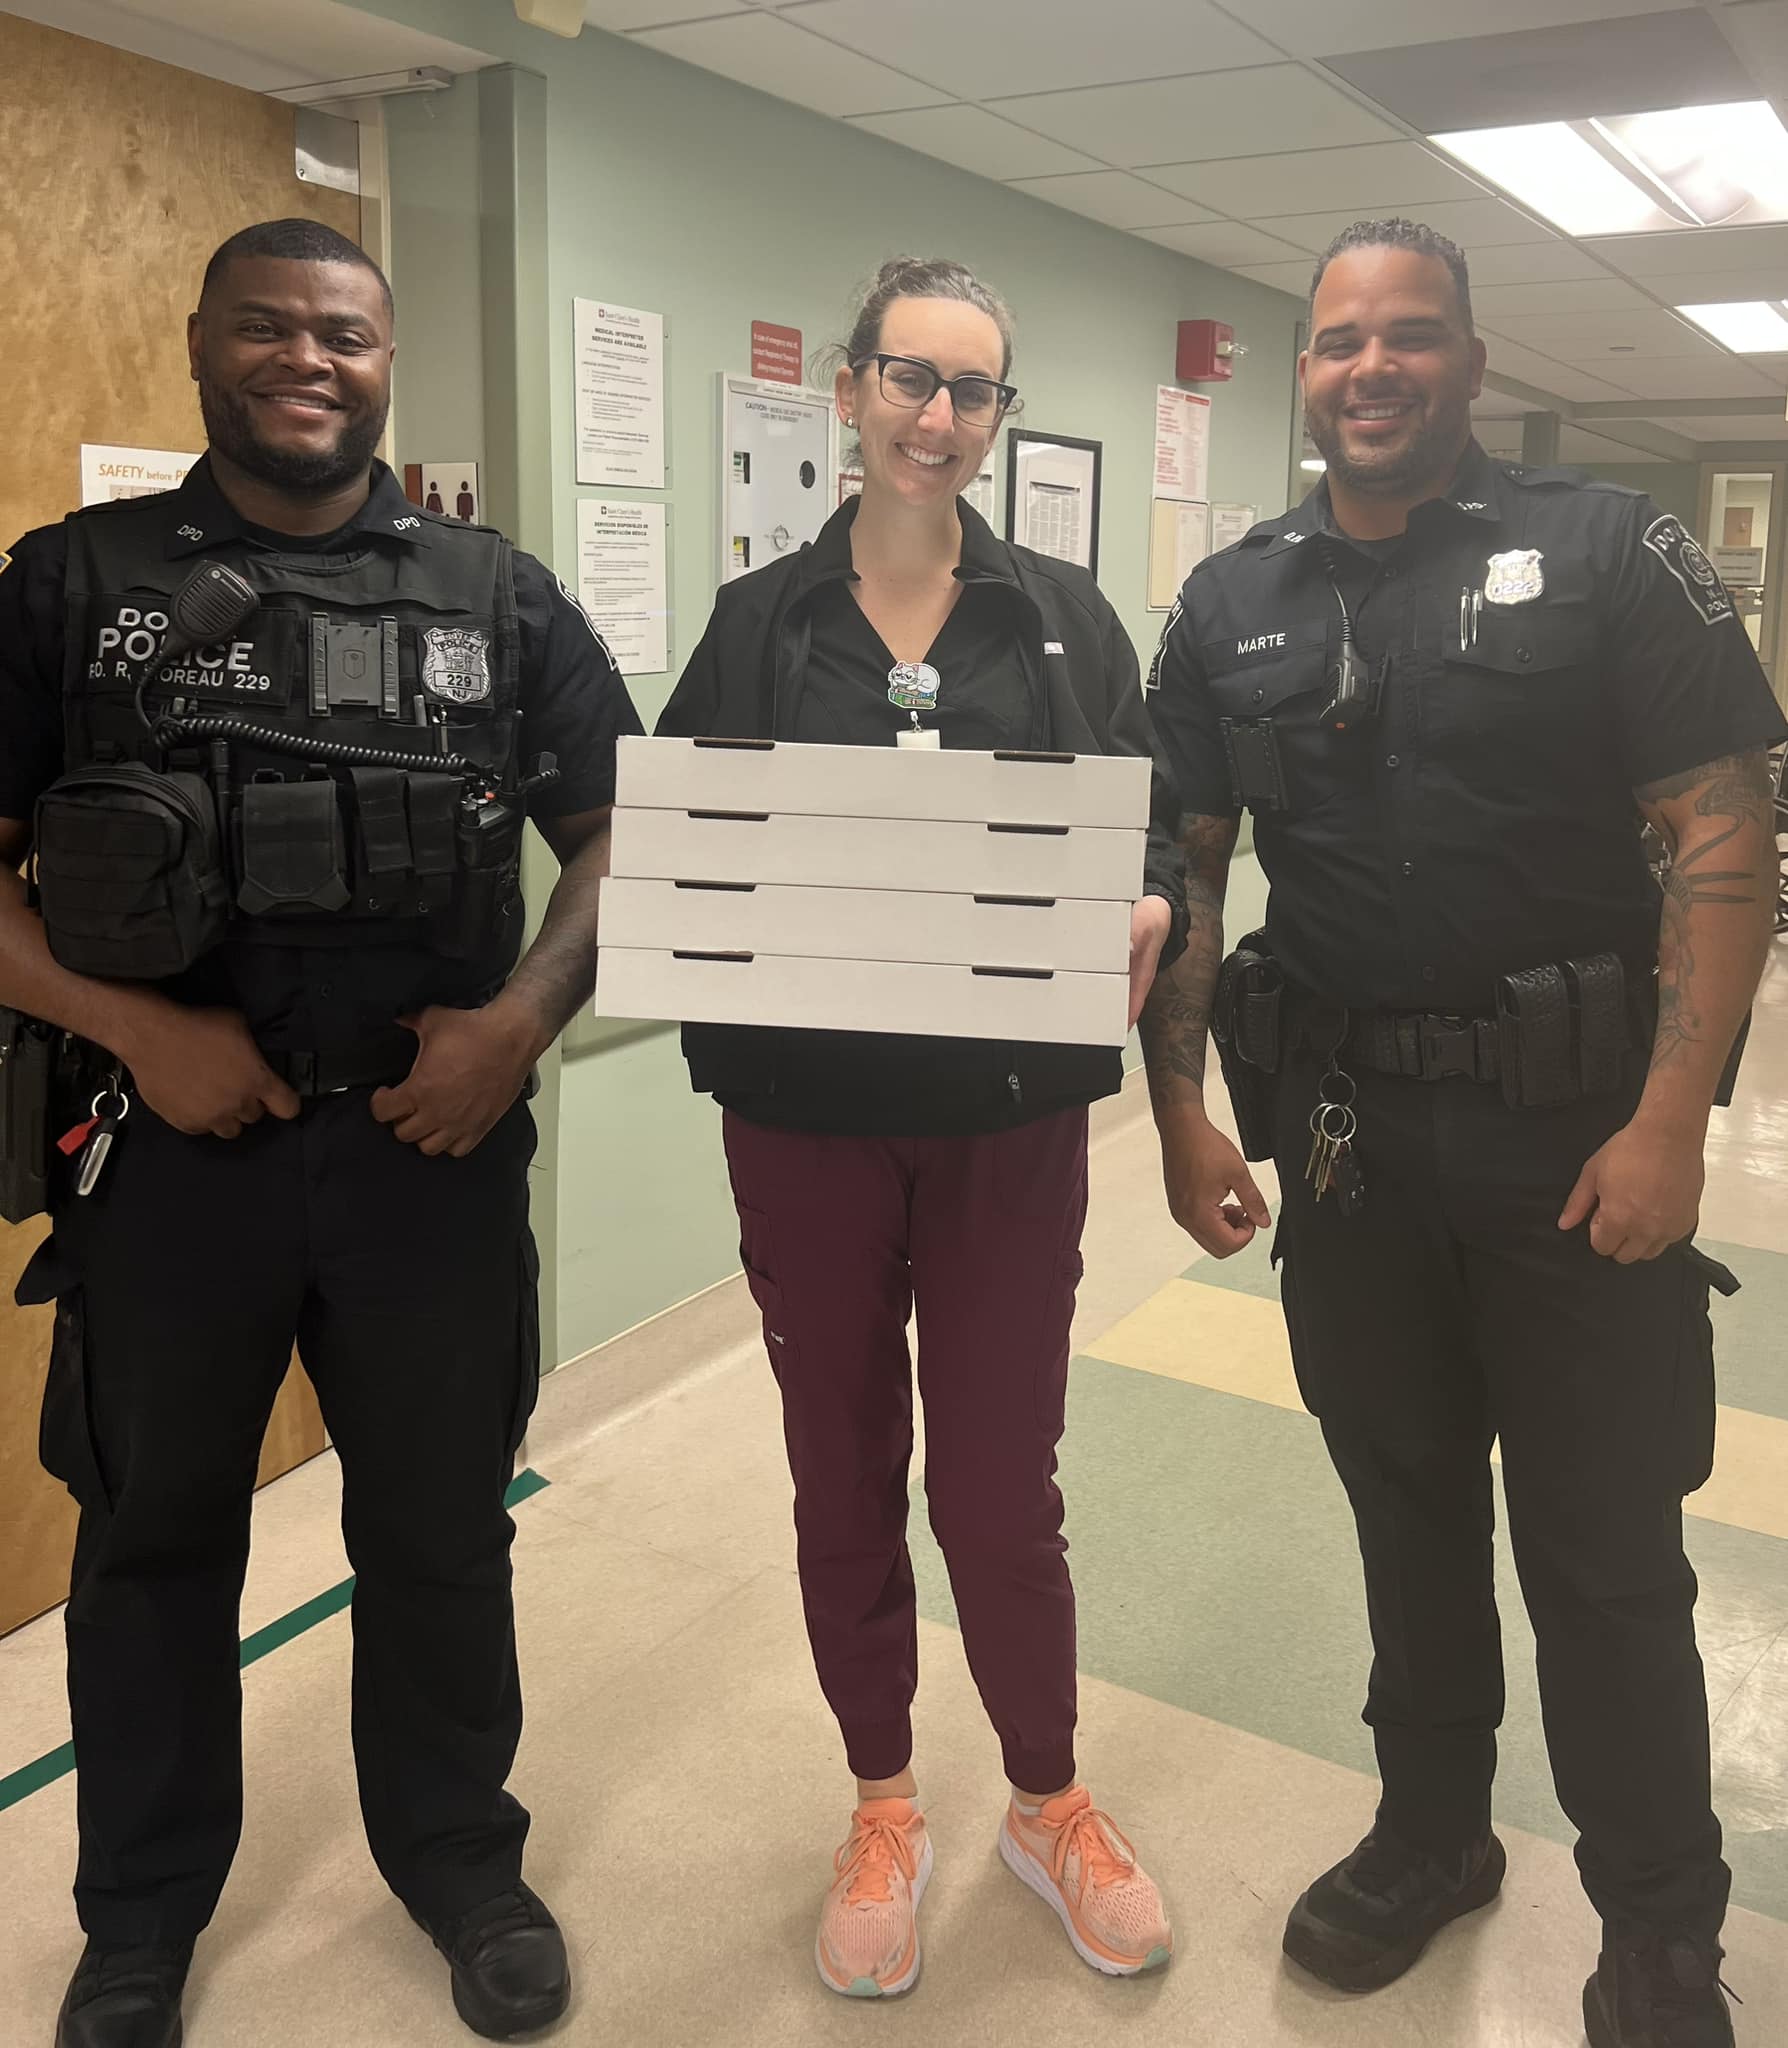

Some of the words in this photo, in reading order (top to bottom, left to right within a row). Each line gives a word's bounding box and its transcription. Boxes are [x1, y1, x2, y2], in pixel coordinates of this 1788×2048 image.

[591, 335, 614, 344] SERVICES
[98, 463, 144, 479] SAFETY
[146, 471, 172, 481] before
[393, 516, 421, 530] DPD
[177, 524, 204, 541] DPD
[117, 607, 169, 631] DO
[1237, 633, 1286, 654] MARTE
[144, 664, 224, 687] OREAU
[233, 673, 271, 690] 229
[447, 674, 472, 687] 229
[452, 689, 467, 698] NJ
